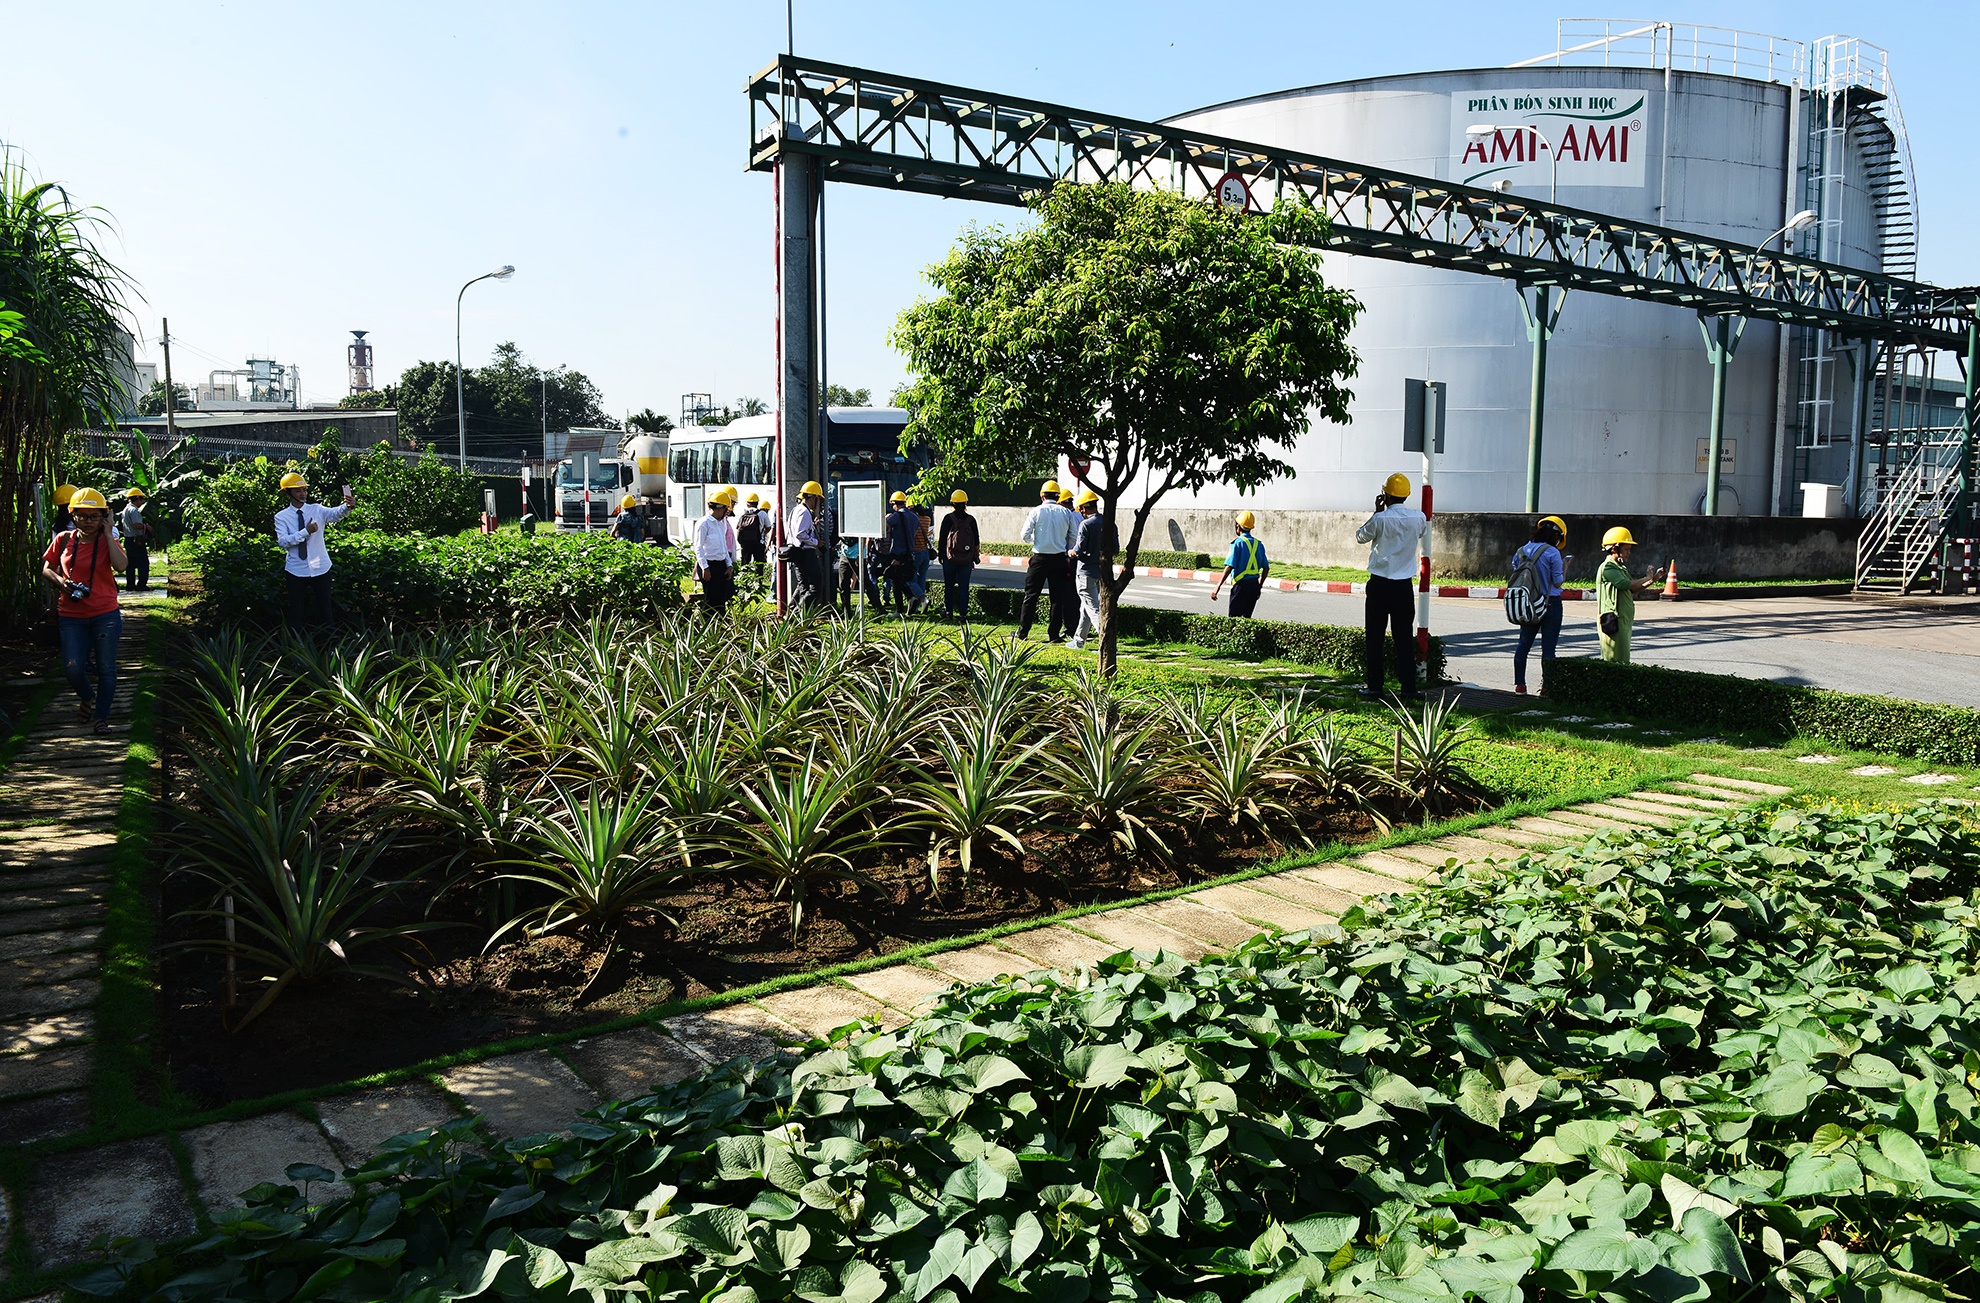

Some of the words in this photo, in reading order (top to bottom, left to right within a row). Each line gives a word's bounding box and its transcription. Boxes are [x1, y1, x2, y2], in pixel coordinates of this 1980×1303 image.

[1467, 95, 1508, 112] PHÂN
[1513, 93, 1544, 111] BÓN
[1548, 96, 1582, 110] SINH
[1588, 96, 1617, 113] HỌC
